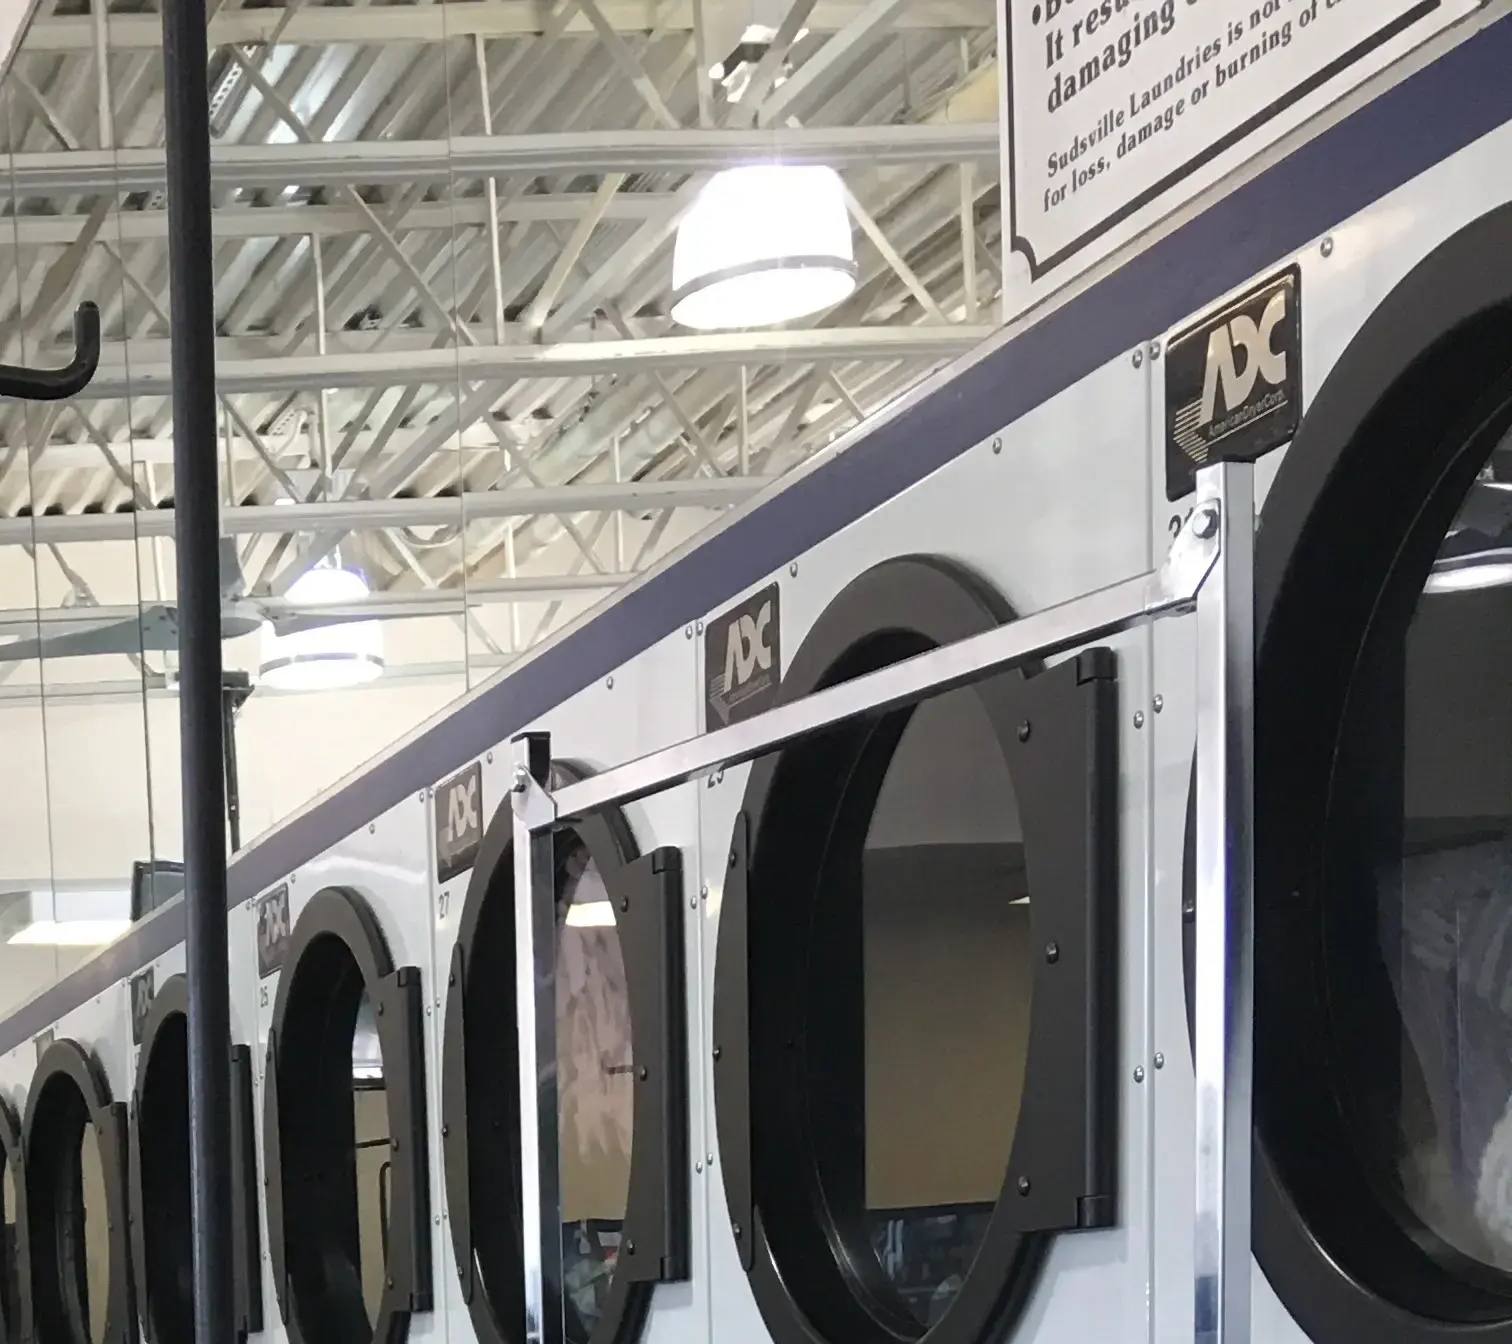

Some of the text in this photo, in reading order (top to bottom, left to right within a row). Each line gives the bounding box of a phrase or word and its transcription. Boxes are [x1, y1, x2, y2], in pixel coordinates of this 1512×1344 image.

[1046, 28, 1064, 69] It
[1048, 0, 1175, 113] damaging
[1048, 109, 1124, 177] Sudsville
[1129, 38, 1221, 118] Laundries
[1228, 21, 1243, 46] is
[1044, 182, 1067, 212] for
[1072, 157, 1111, 192] loss,
[1117, 98, 1185, 158] damage
[1191, 80, 1209, 106] or
[1216, 20, 1292, 88] burning
[1198, 290, 1286, 425] ADC
[724, 600, 772, 693] ADC
[447, 775, 478, 842] ADC
